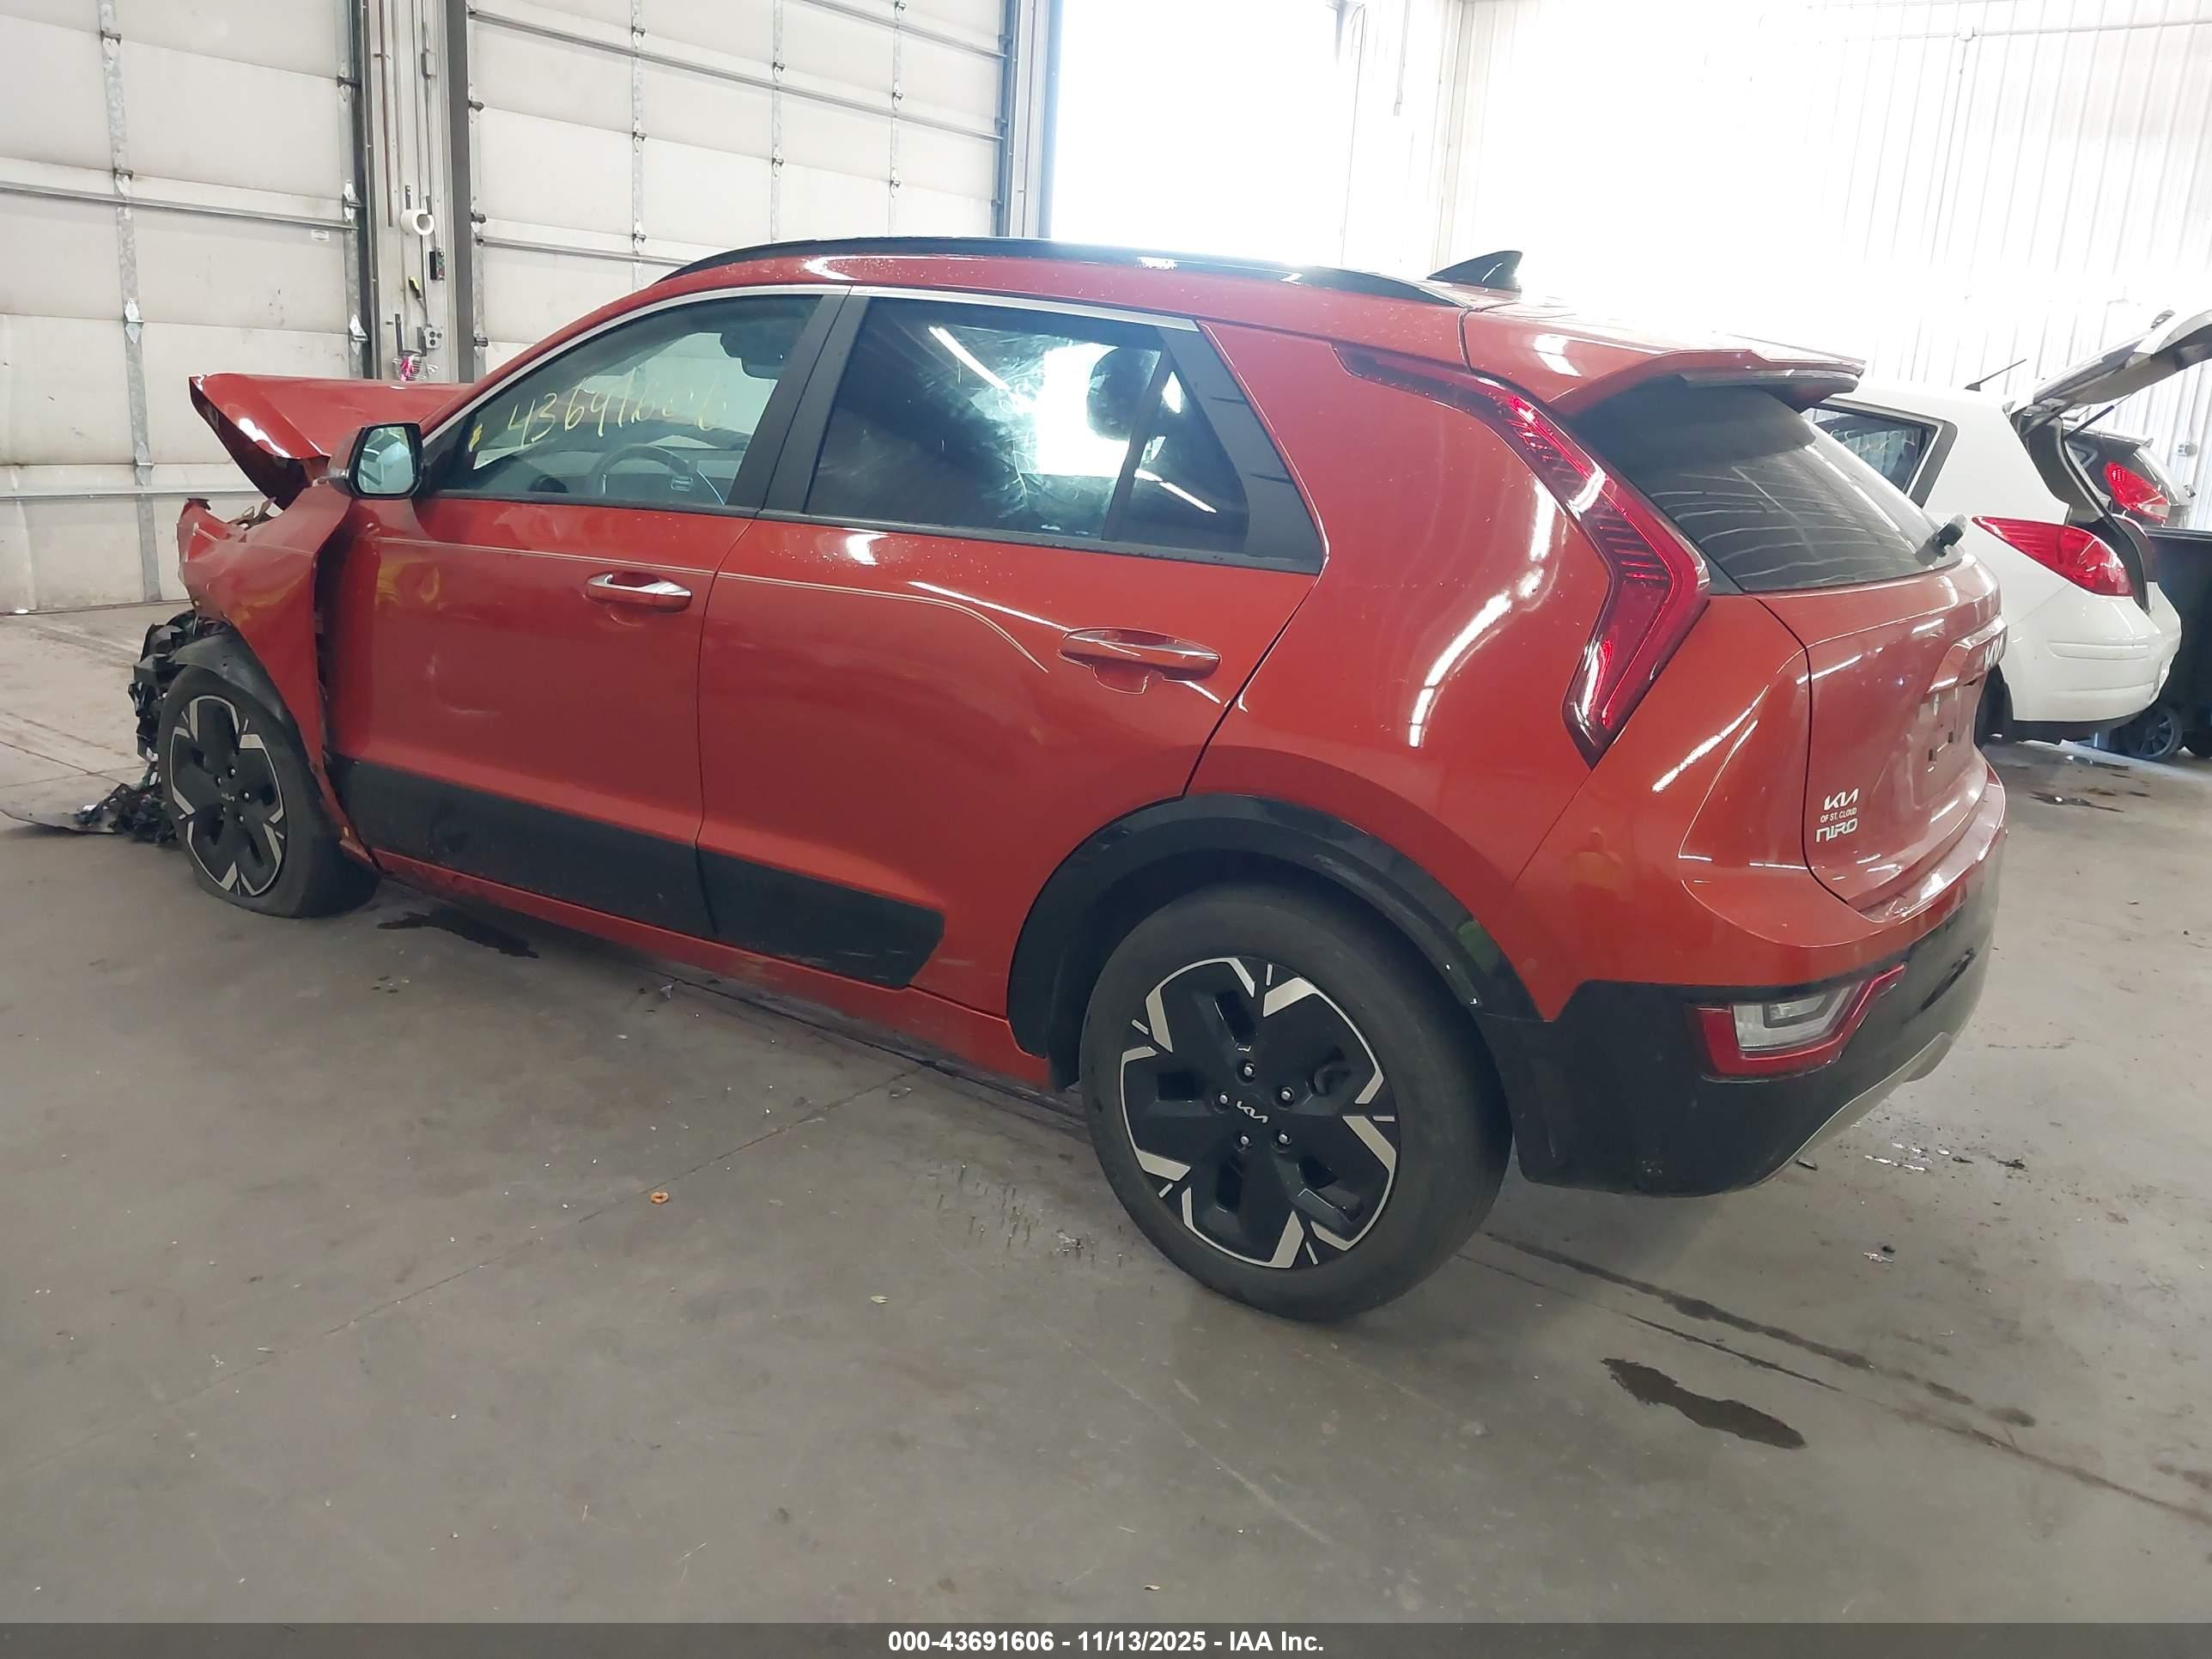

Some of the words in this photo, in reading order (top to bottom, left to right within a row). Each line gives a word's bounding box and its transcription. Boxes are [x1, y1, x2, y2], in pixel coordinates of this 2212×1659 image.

[1823, 787, 1859, 811] KIA
[1820, 814, 1830, 823] OF
[1838, 807, 1857, 819] CLOUD
[1237, 1100, 1268, 1123] KIA
